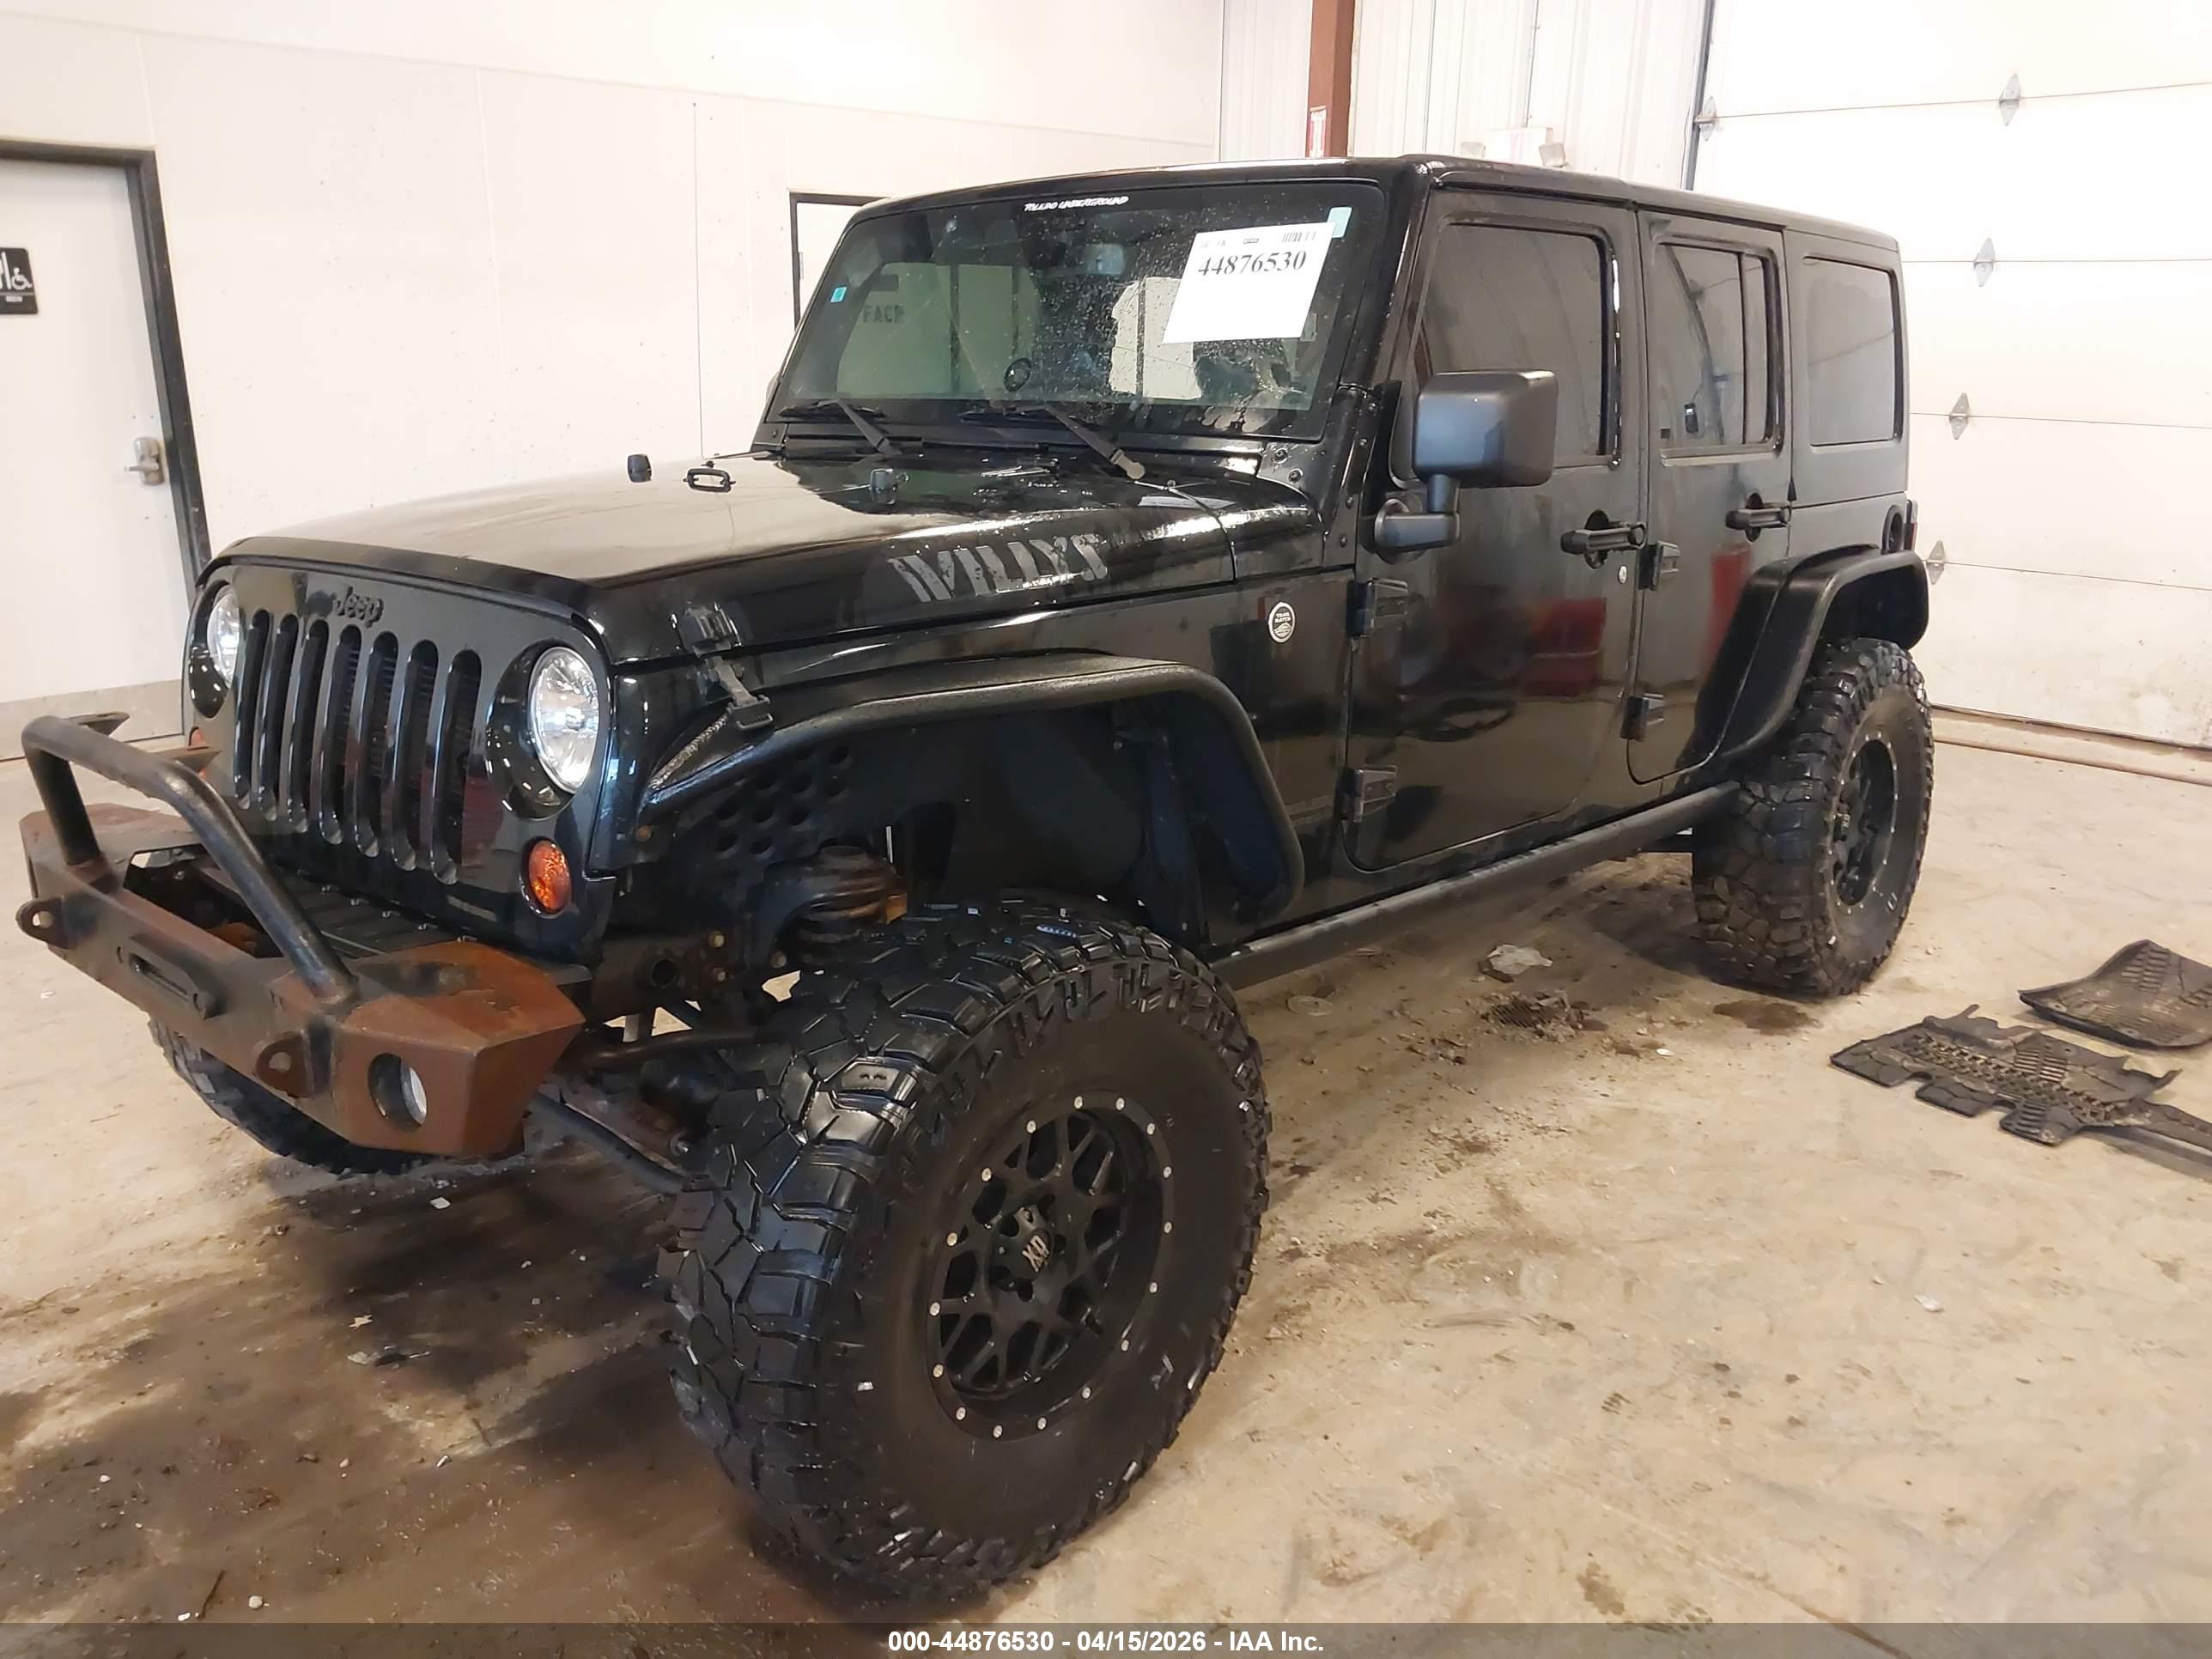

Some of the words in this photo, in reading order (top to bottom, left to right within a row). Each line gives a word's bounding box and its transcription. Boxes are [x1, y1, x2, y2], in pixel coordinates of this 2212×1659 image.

[1024, 202, 1058, 212] TOLEDO
[1058, 196, 1129, 209] UNDERGROUND
[1198, 250, 1306, 276] 44876530
[887, 533, 1108, 602] WILLYS
[331, 586, 384, 628] Jeep
